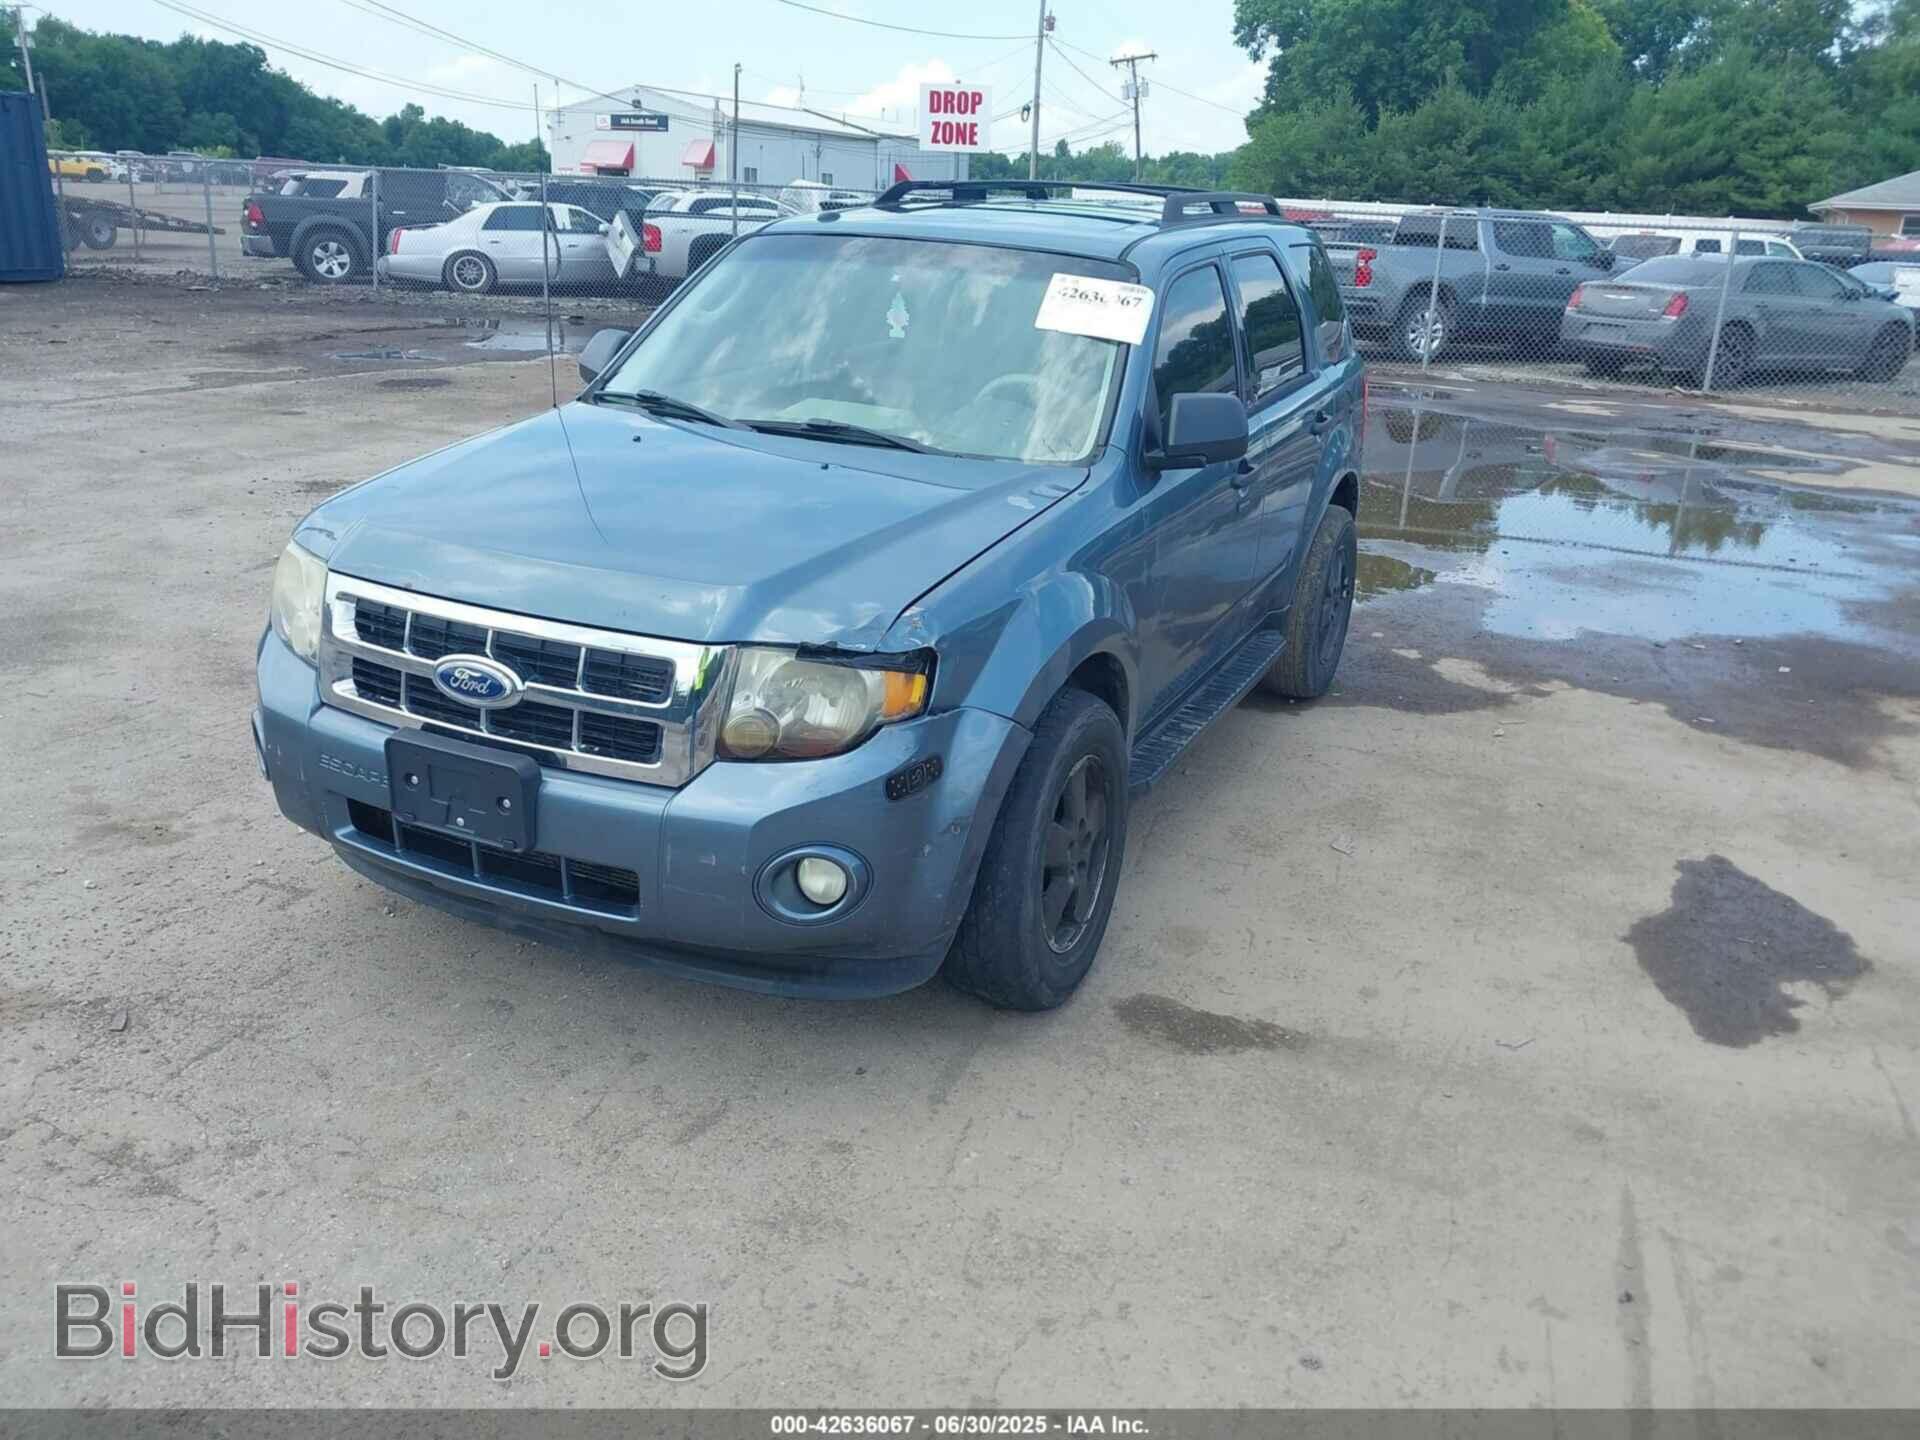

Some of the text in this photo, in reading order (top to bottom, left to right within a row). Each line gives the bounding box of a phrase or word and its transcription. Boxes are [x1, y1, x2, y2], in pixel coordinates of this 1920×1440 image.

[929, 90, 983, 115] DROP
[931, 121, 978, 146] ZONE
[449, 667, 491, 694] Ford
